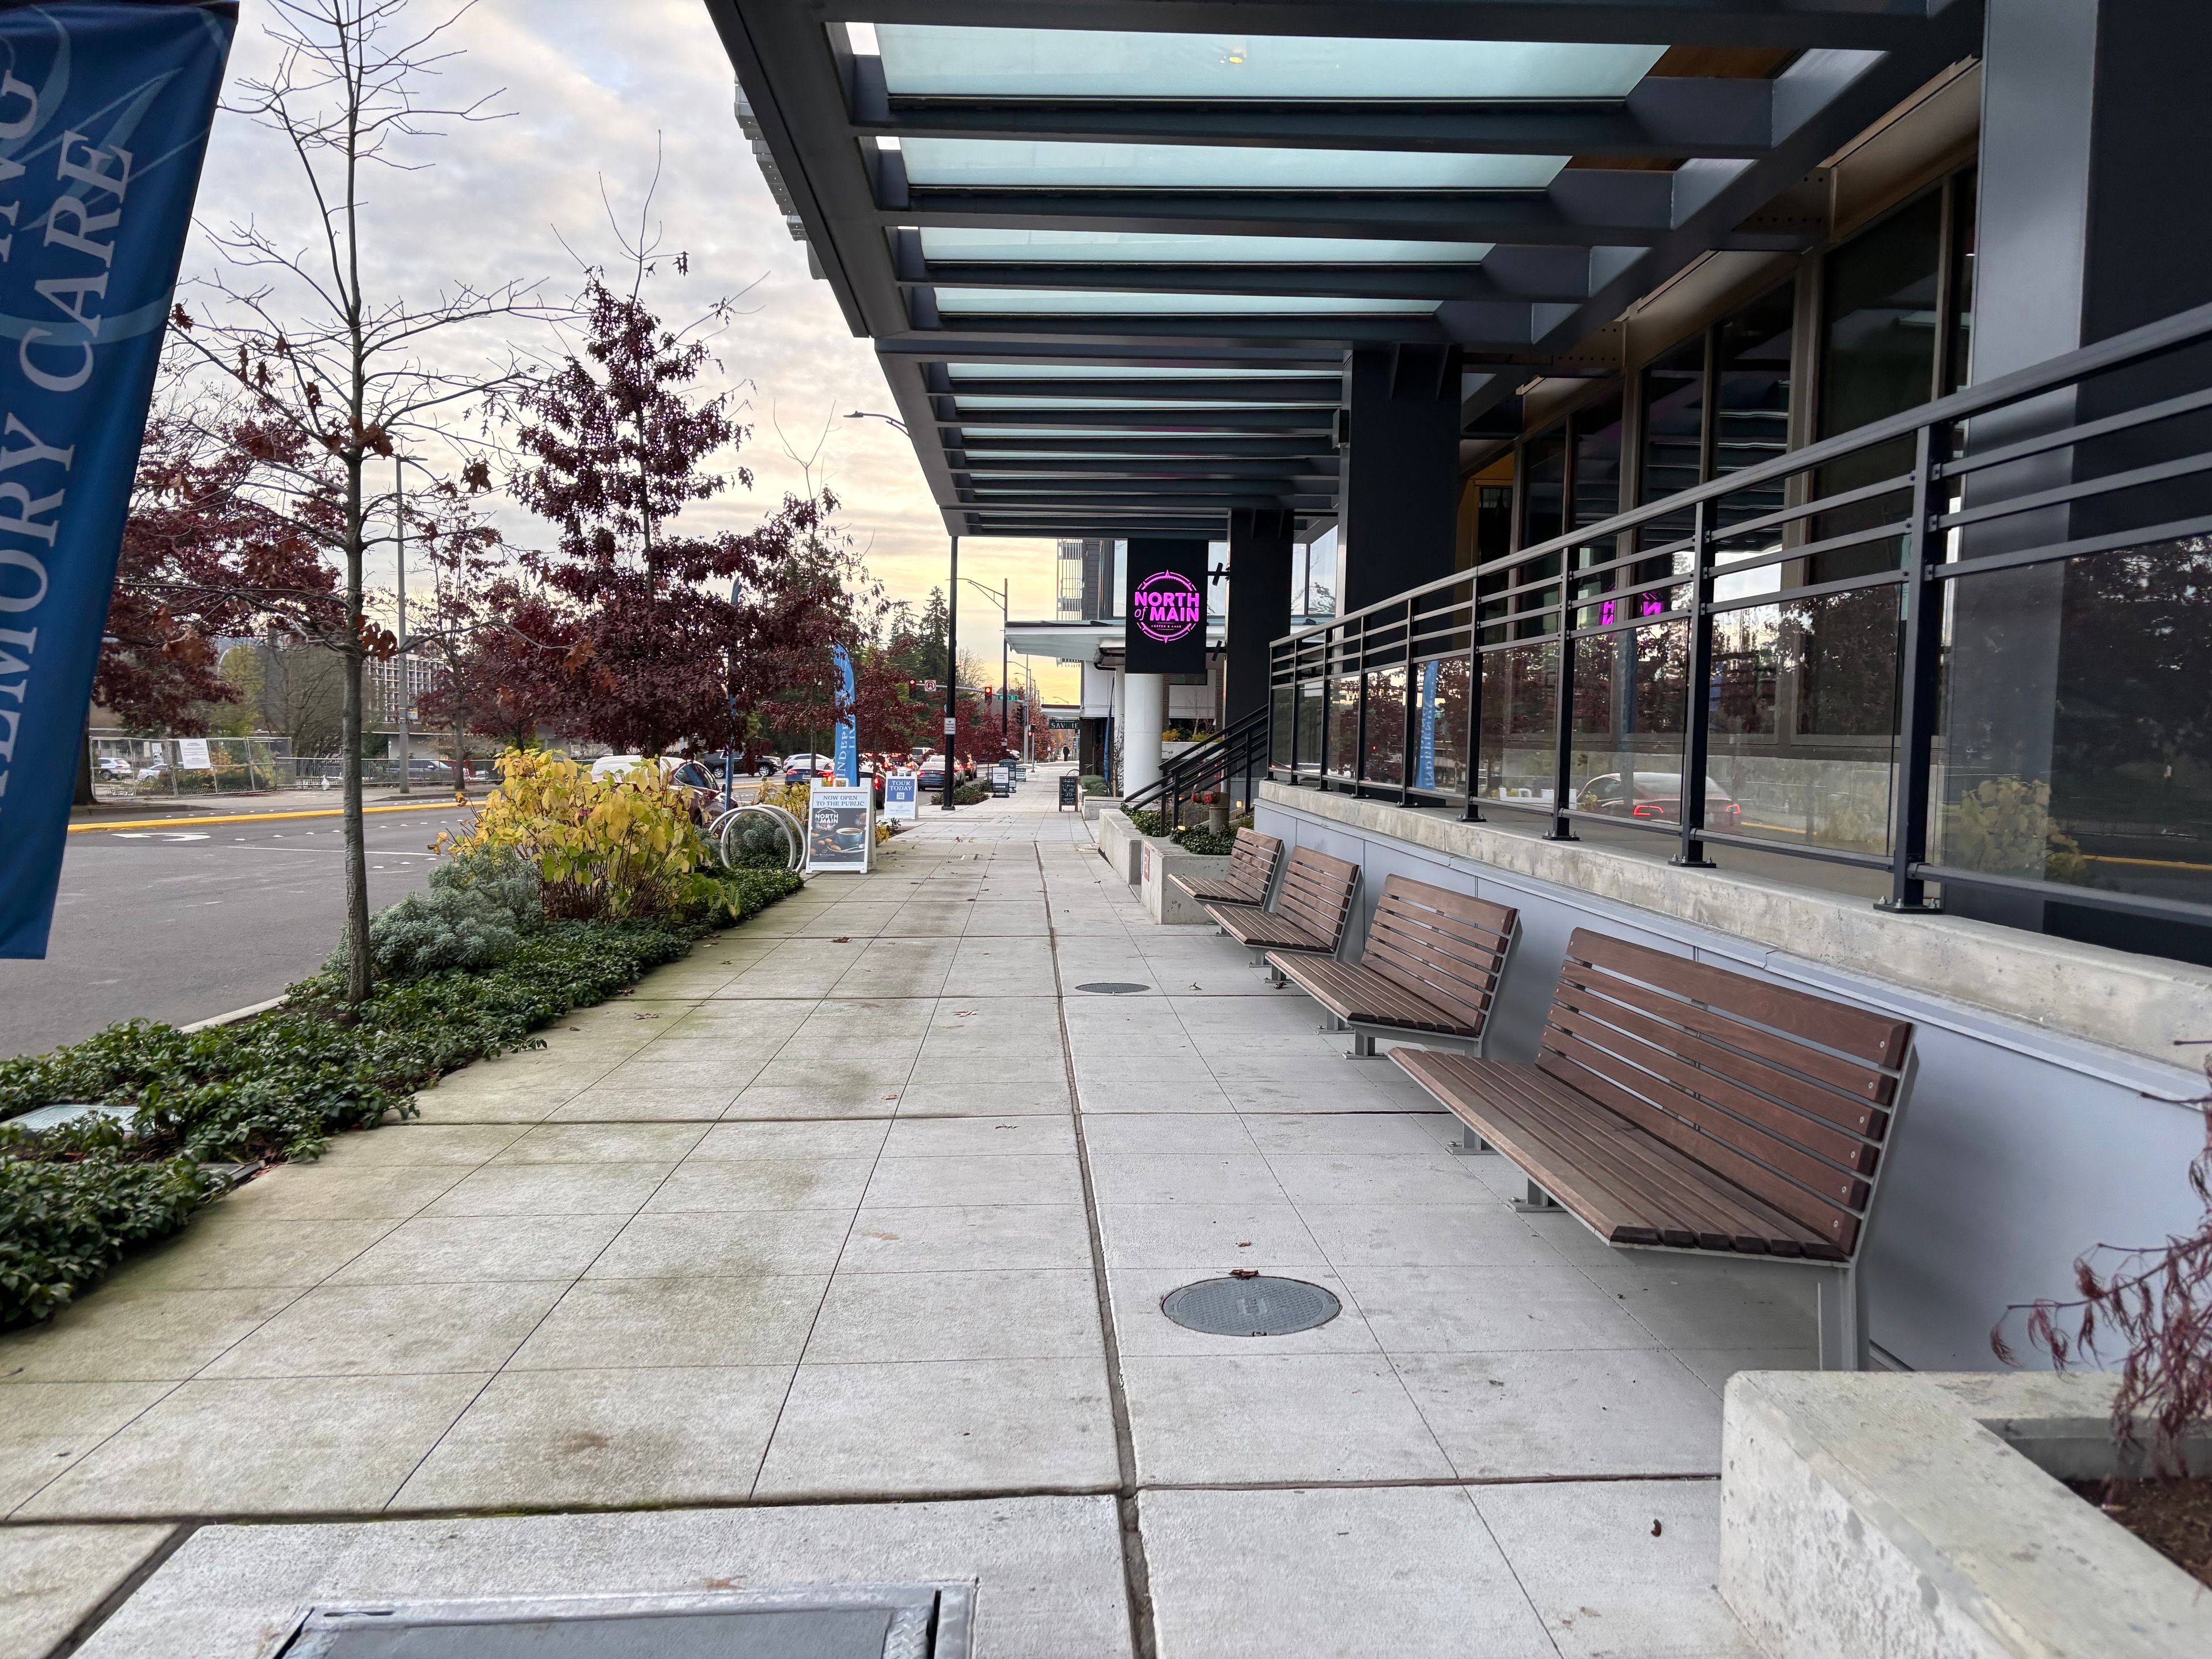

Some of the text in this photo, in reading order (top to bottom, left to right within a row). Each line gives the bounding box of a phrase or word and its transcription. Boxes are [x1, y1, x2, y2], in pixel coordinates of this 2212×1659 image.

[20, 130, 133, 392] CARE
[1135, 592, 1199, 607] NORTH
[1134, 606, 1199, 622] of MAIN
